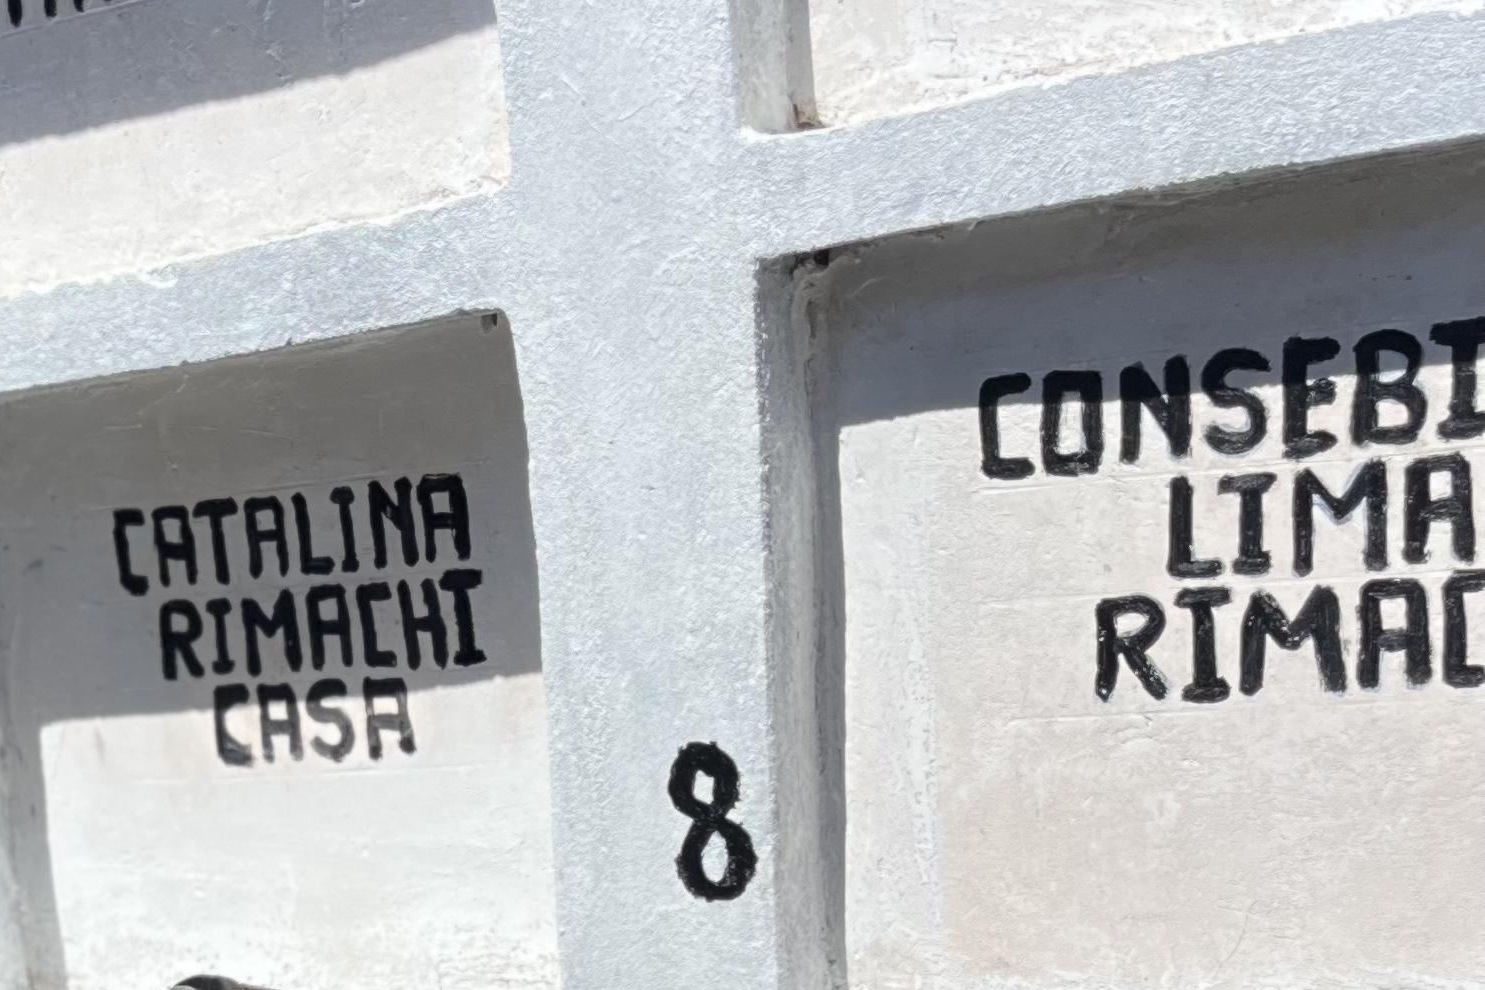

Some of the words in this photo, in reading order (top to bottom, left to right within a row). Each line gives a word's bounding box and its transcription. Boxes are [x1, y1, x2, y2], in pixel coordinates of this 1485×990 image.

[113, 473, 471, 596] CATALINA
[1166, 452, 1476, 579] LIMA
[159, 568, 487, 680] RIMACHI
[1095, 568, 1485, 703] RIMAC
[214, 677, 417, 766] CASA
[667, 741, 758, 903] 8
